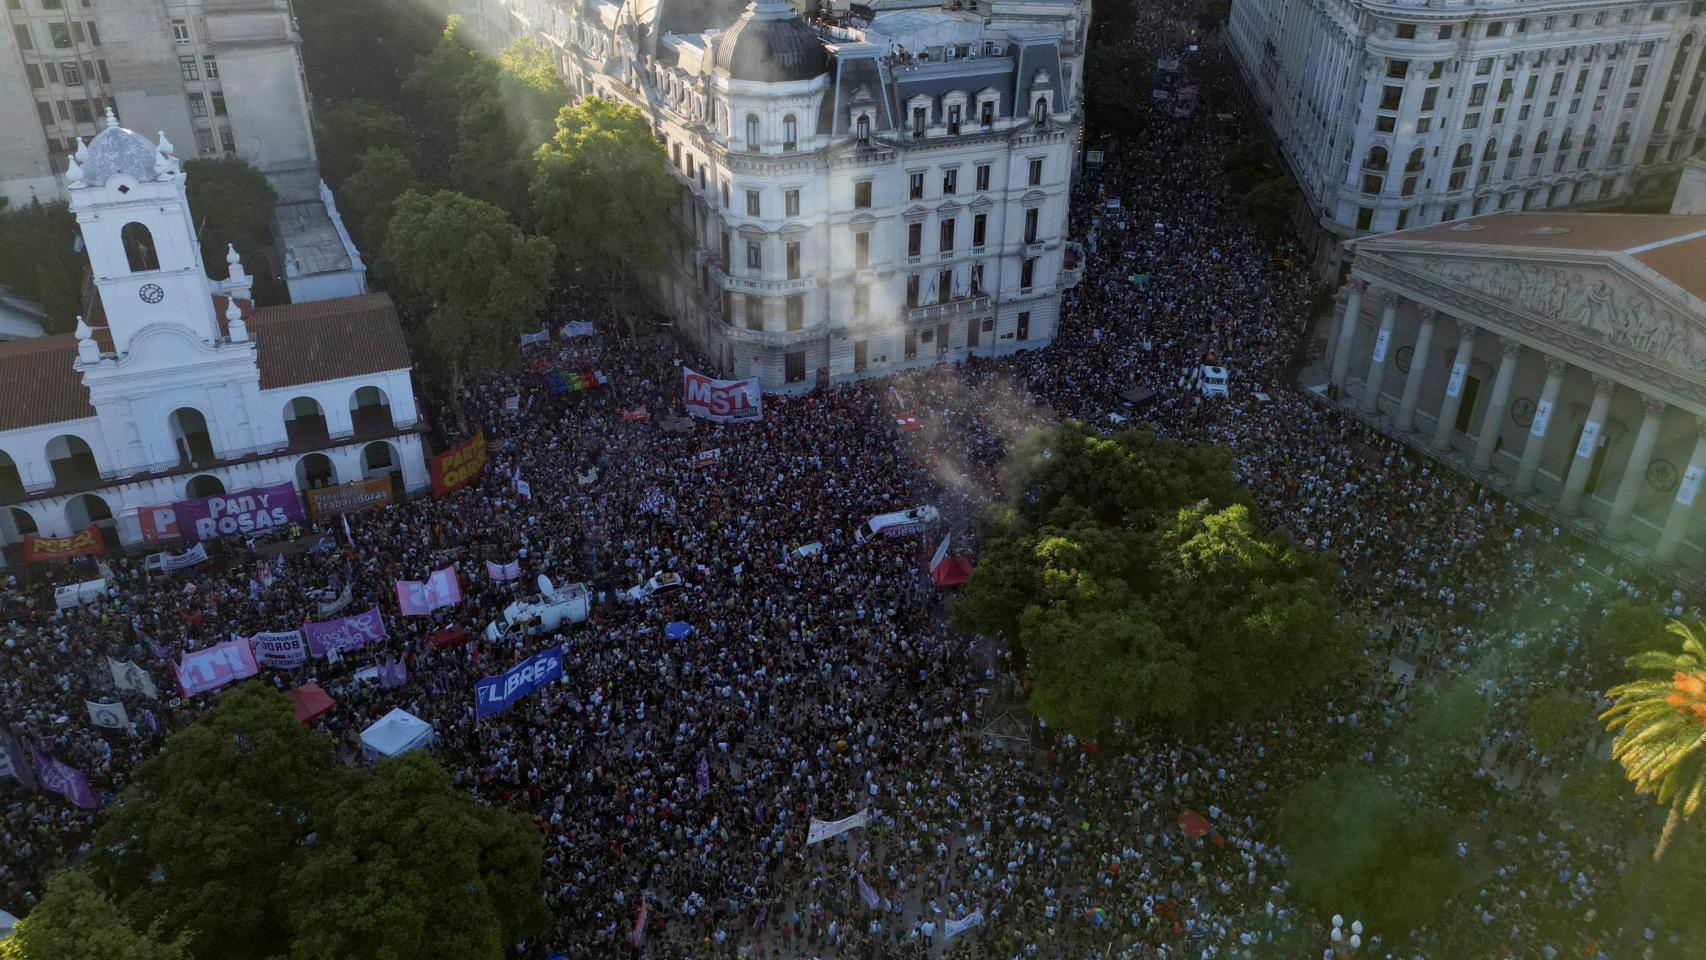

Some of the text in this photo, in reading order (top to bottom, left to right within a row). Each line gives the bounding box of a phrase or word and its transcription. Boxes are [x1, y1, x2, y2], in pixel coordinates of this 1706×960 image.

[688, 378, 746, 414] MST
[256, 494, 270, 508] Y
[153, 509, 176, 533] P
[196, 507, 289, 540] ROSAS
